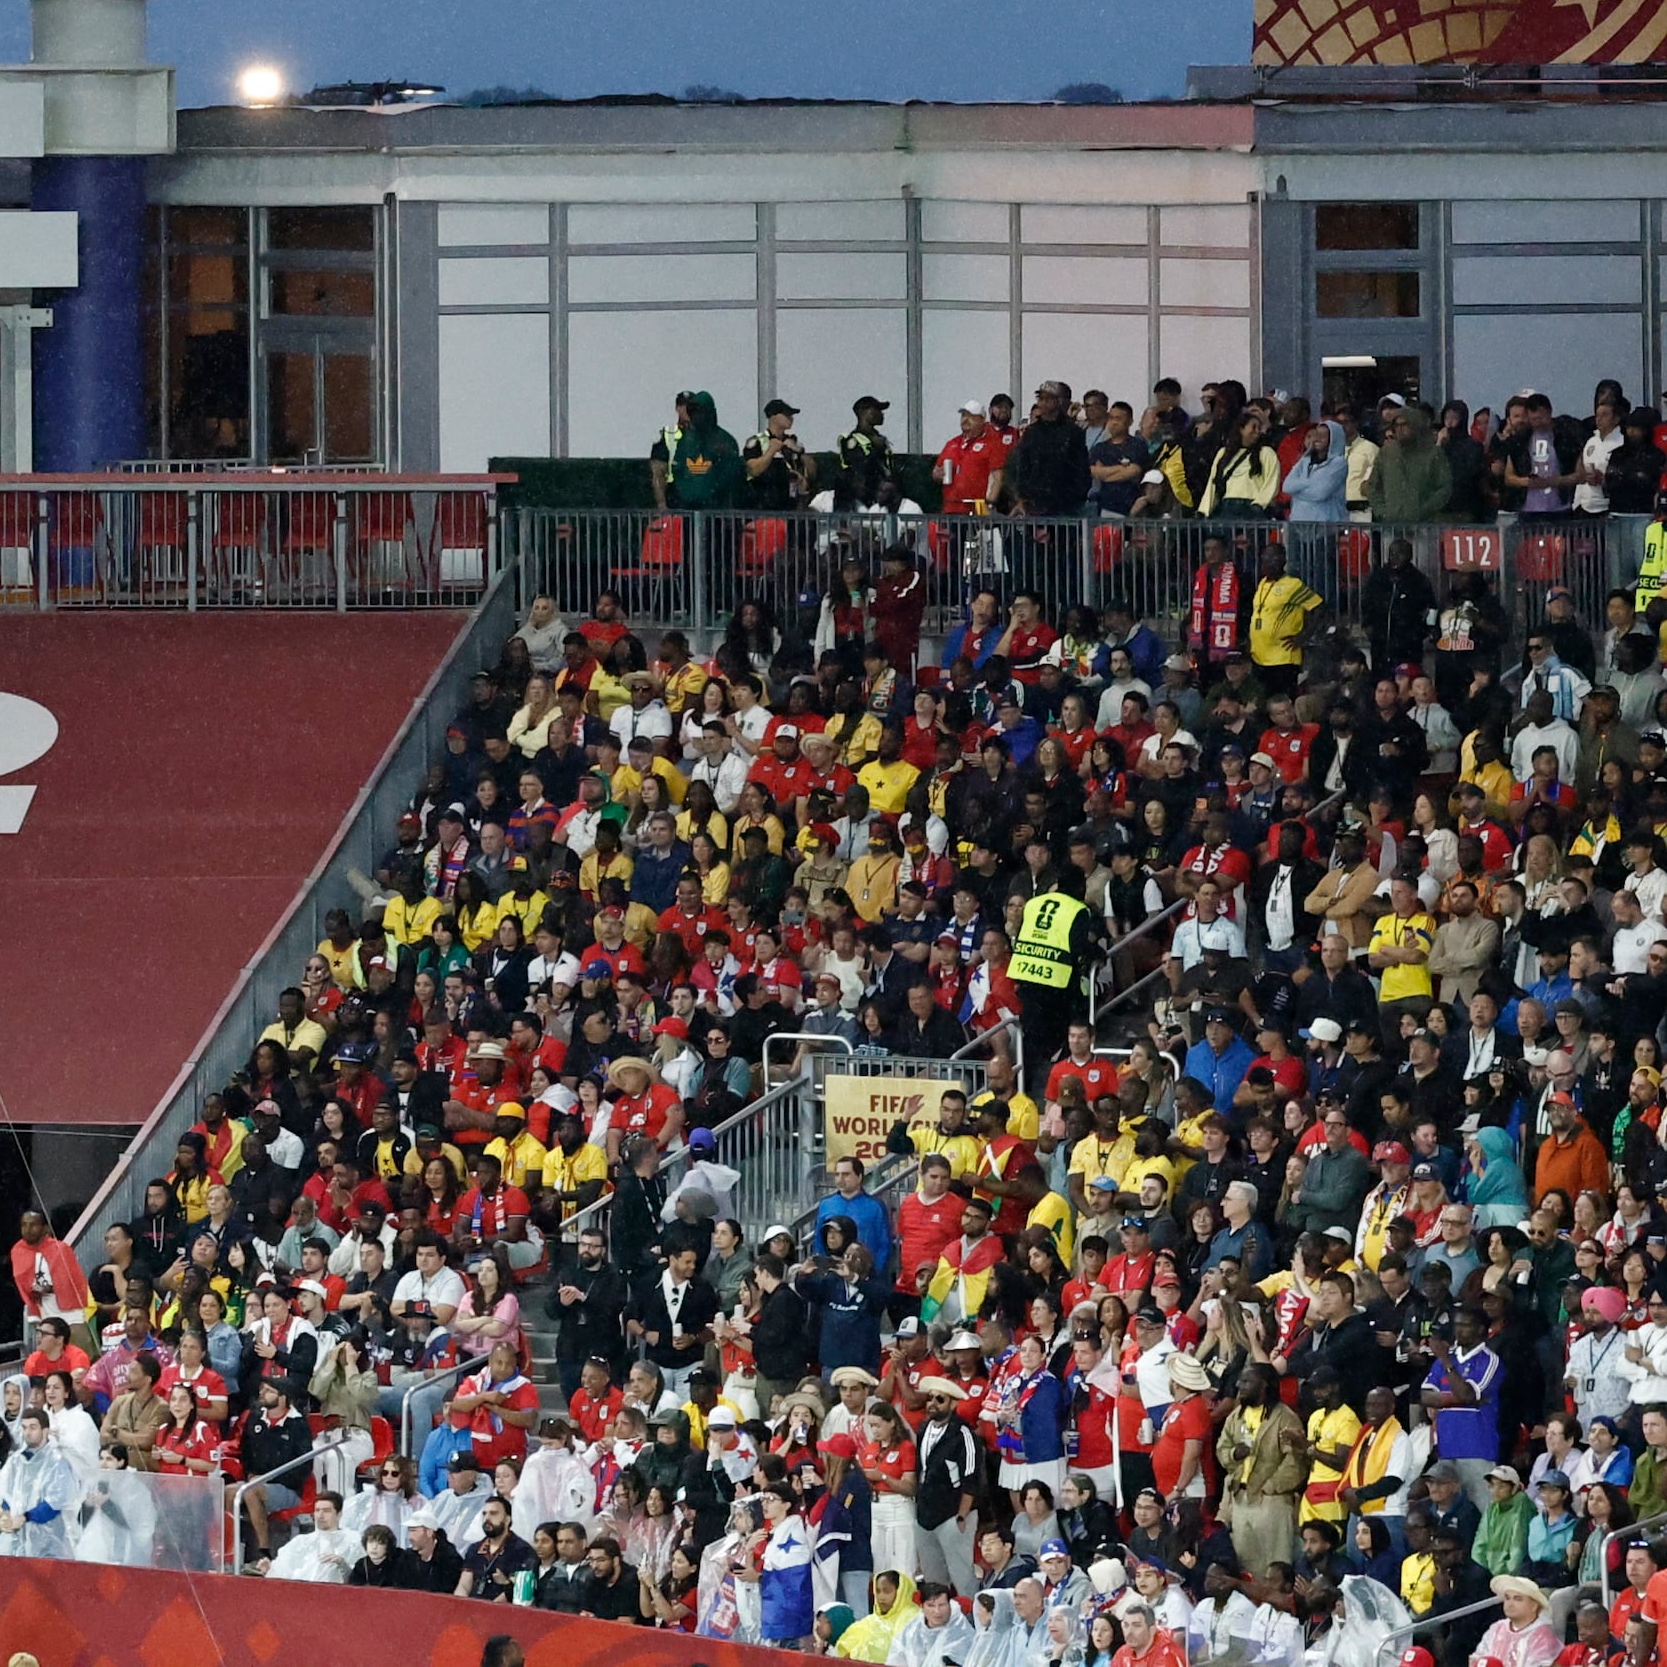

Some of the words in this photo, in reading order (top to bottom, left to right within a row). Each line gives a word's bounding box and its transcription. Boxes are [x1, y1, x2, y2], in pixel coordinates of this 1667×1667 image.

[1452, 536, 1491, 566] 112
[1014, 942, 1062, 961] SECURITY
[1017, 961, 1054, 979] 17443
[833, 1116, 901, 1136] WORL
[855, 1141, 887, 1160] 20
